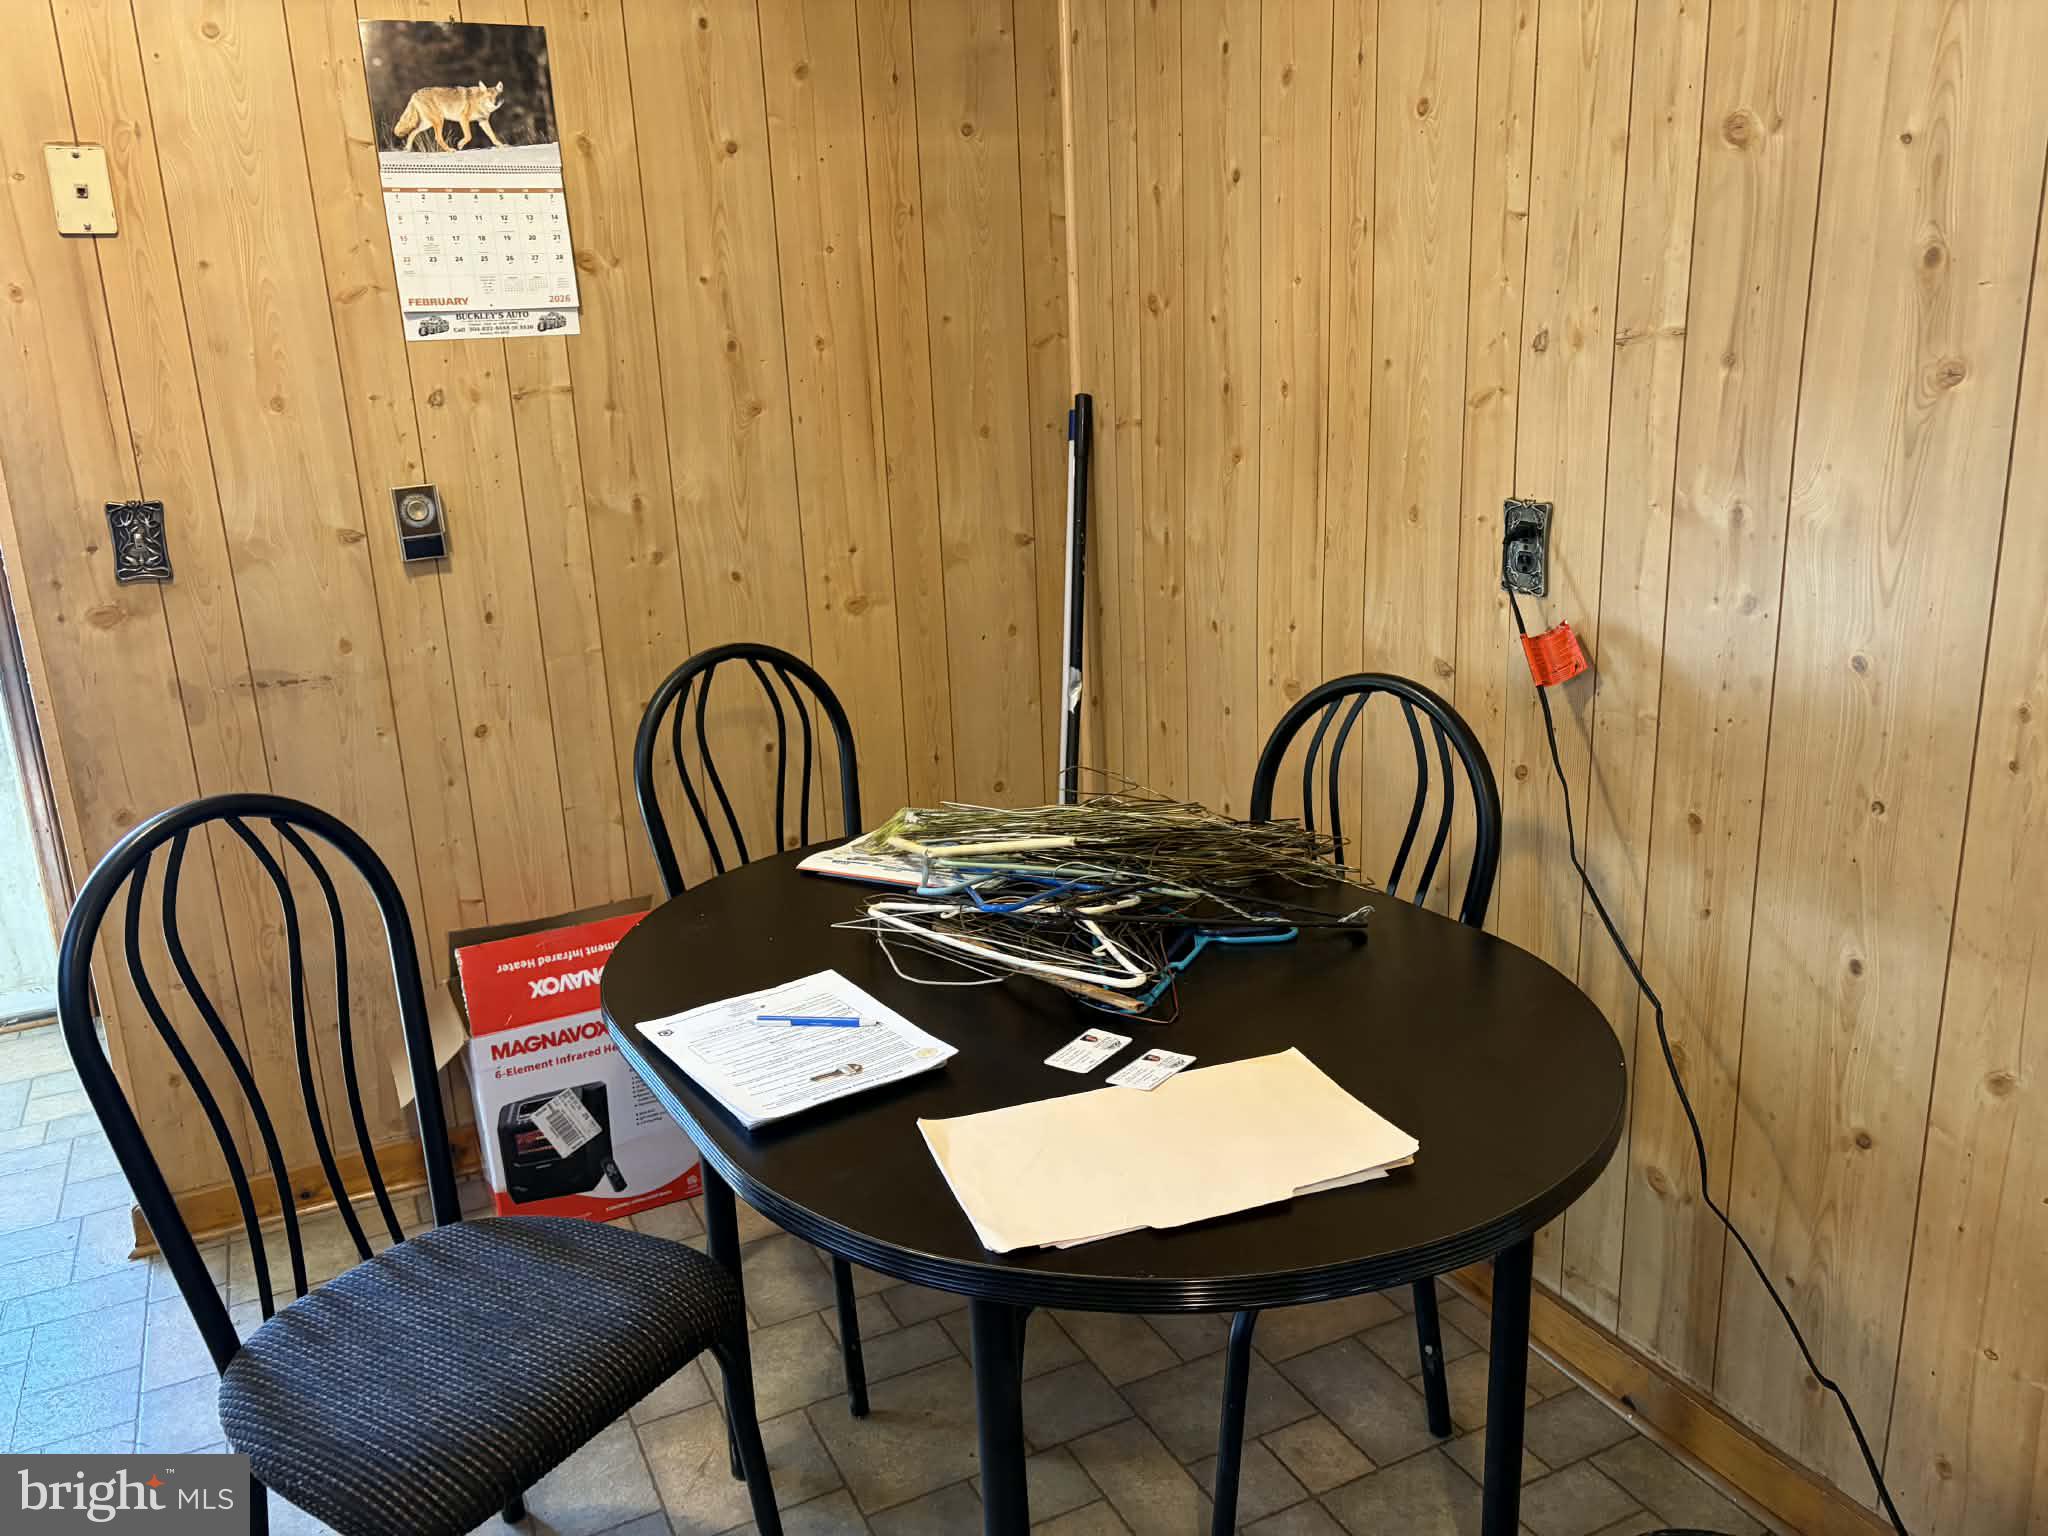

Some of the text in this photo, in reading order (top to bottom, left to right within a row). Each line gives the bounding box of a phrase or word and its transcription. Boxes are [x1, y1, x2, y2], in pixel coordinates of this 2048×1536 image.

[408, 297, 469, 306] FEBRUARY
[549, 294, 571, 303] 2026
[456, 311, 504, 320] BUCKLEY'S
[496, 940, 620, 974] ment Infrared Heater
[528, 966, 605, 999] NAVOX
[490, 1021, 608, 1061] MAGNAVOX
[495, 1043, 618, 1079] 6-Element Infrared He
